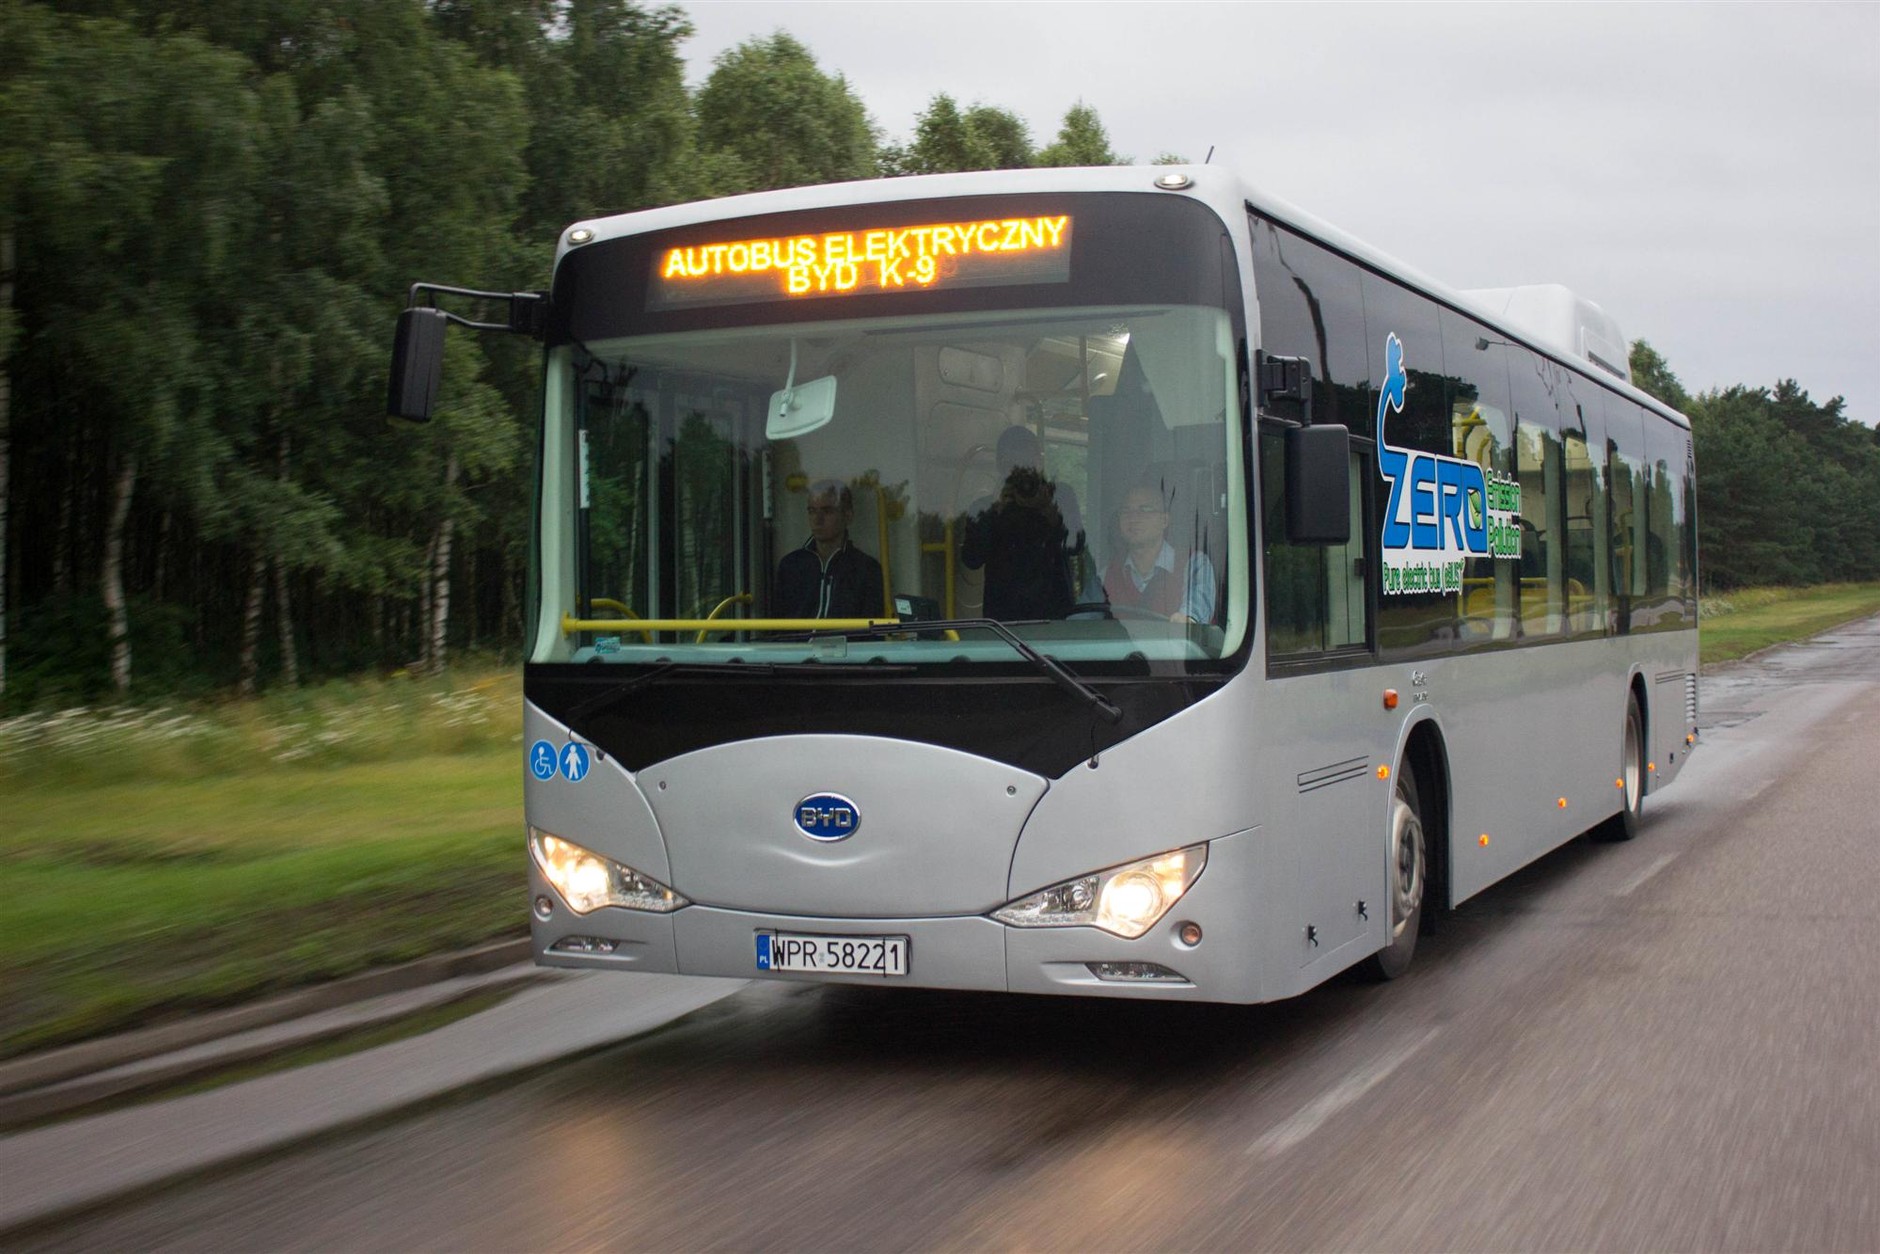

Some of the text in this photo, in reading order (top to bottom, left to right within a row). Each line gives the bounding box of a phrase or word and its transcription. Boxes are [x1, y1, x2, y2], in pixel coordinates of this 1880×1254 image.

[663, 216, 1068, 278] AUTOBUS ELEKTRYCZNY
[787, 253, 936, 295] BYD K-9
[1380, 449, 1488, 554] ZERO
[1383, 560, 1401, 593] Pure
[800, 807, 852, 828] BYD
[772, 939, 899, 971] WPR 58221
